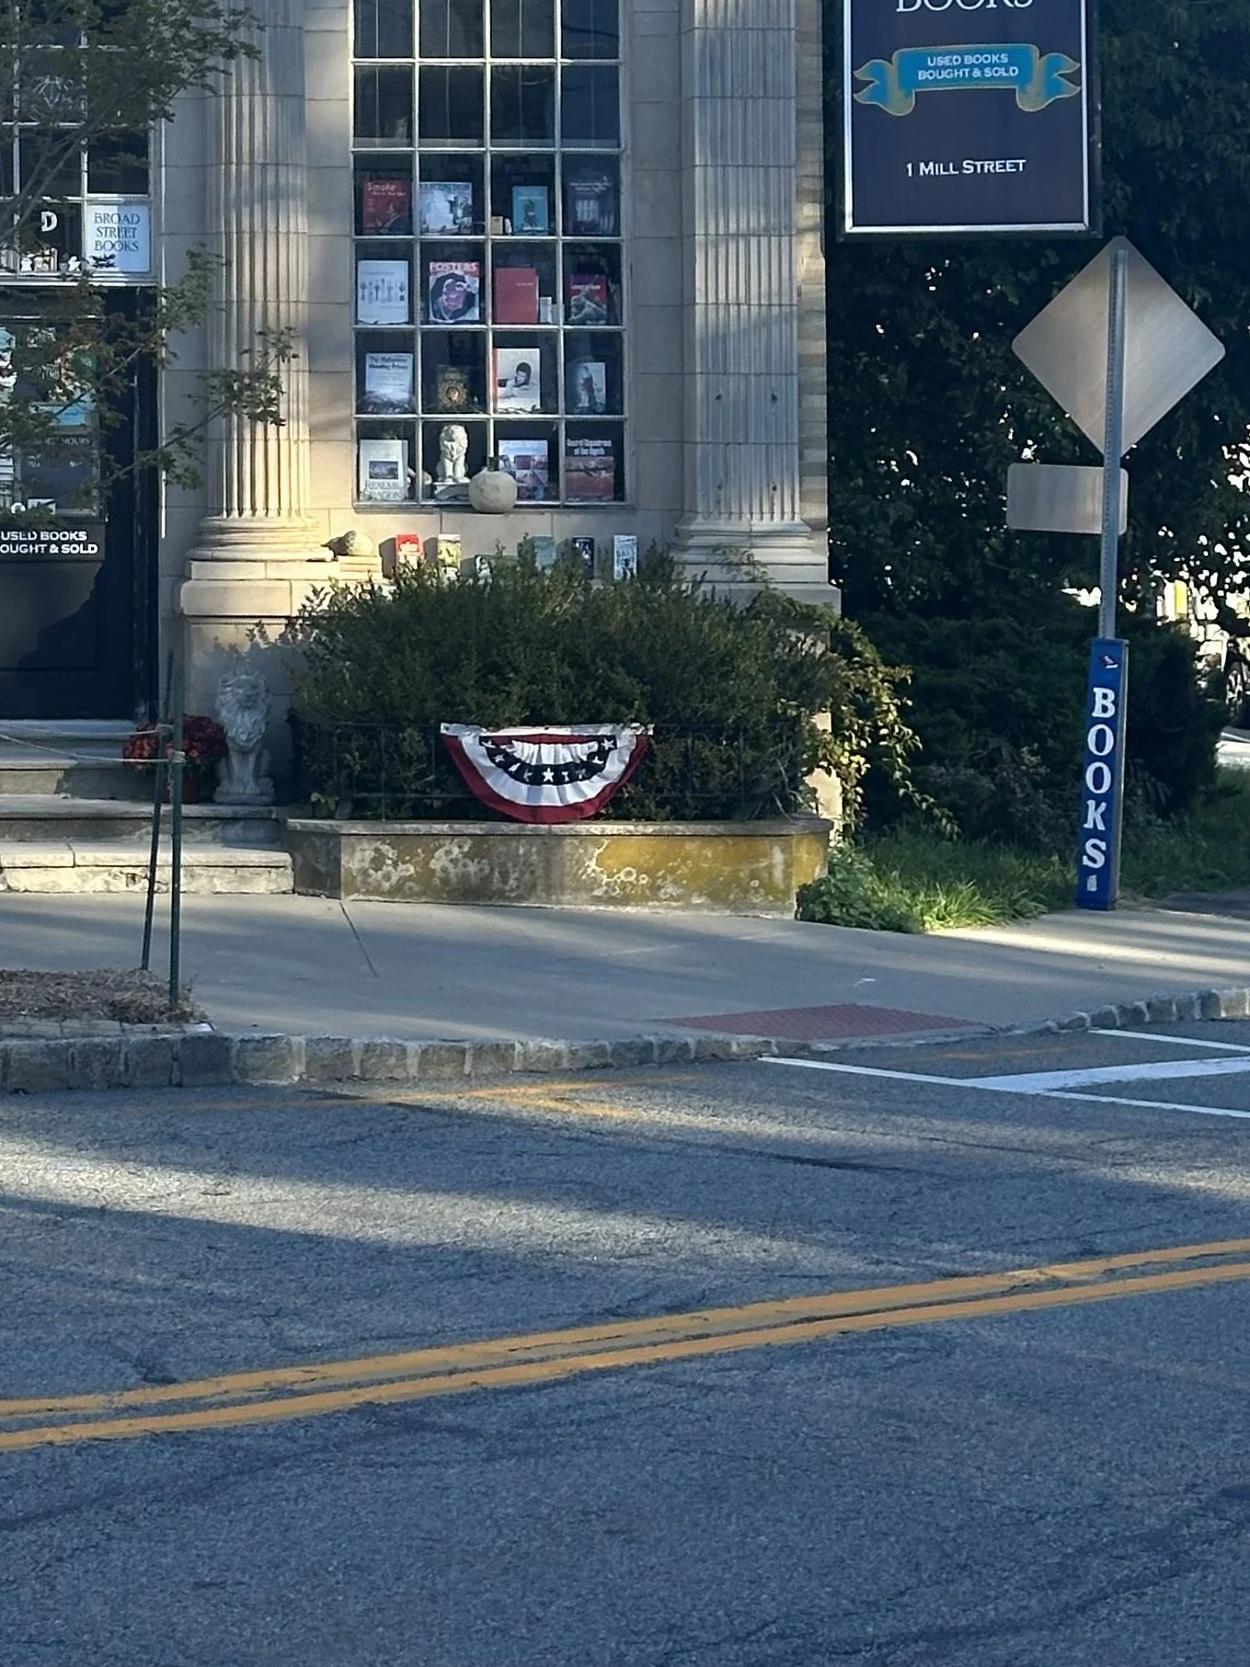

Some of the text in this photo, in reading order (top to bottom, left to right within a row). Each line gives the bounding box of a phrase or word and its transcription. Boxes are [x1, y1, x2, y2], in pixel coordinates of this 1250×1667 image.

[927, 52, 1009, 67] USED BOOKS
[917, 65, 1019, 81] BOUGHT & SOLD
[906, 159, 1027, 177] 1 MILL STREET
[94, 212, 140, 225] BROAD
[96, 226, 138, 239] STREET
[94, 239, 140, 252] BOOKS
[40, 531, 88, 541] BOOKS
[49, 543, 59, 554] &
[61, 543, 99, 554] SOLD
[1082, 687, 1116, 868] BOOKS
